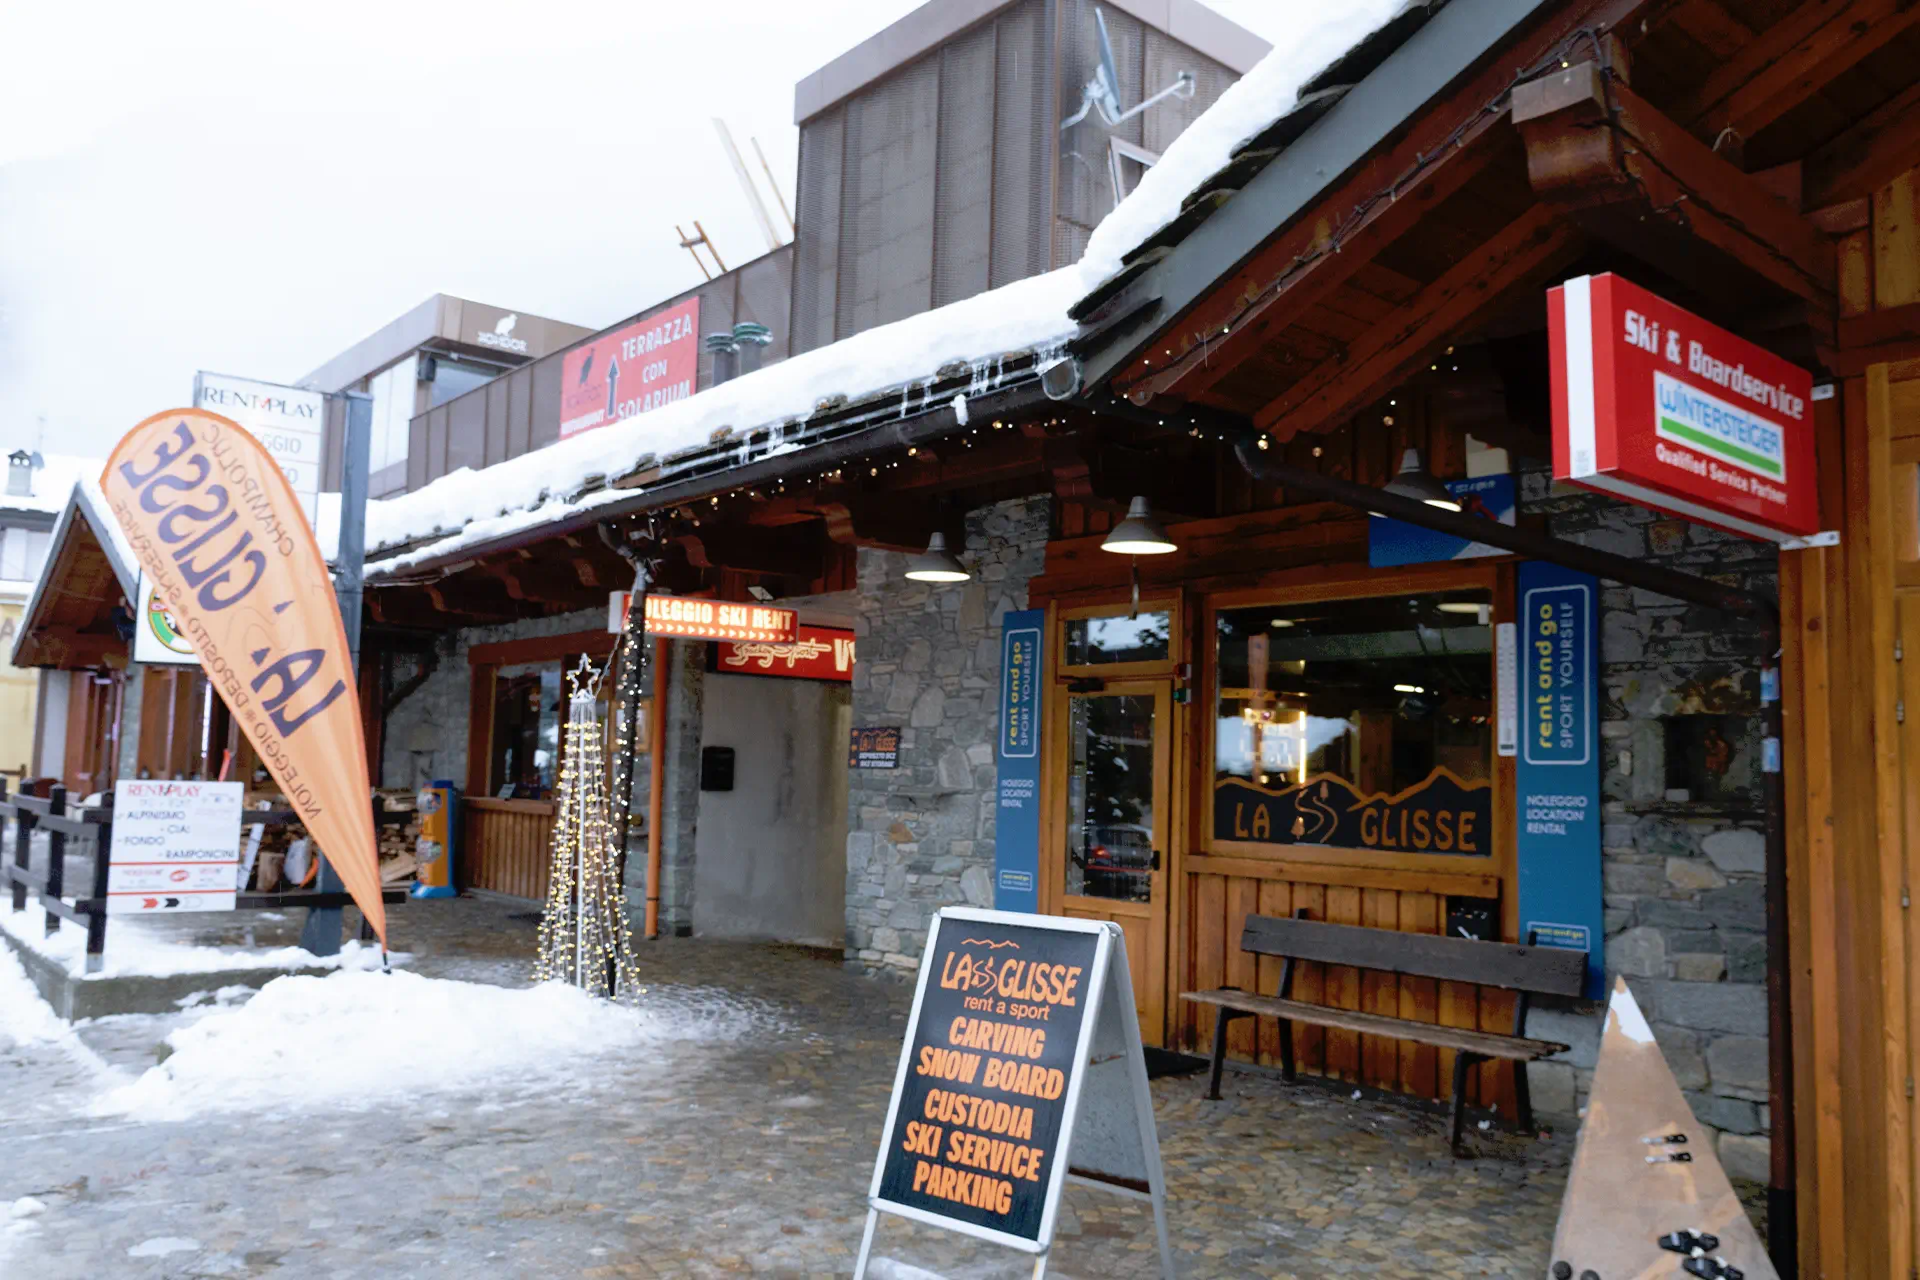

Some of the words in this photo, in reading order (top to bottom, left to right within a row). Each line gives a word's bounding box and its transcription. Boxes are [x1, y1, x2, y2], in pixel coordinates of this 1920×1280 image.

[622, 313, 692, 362] TERRAZZA
[642, 360, 668, 384] CON
[1624, 309, 1659, 355] Ski
[1665, 330, 1681, 365] &
[1689, 339, 1804, 420] Boardservice
[618, 379, 690, 420] SOLARIUM
[1659, 383, 1781, 457] WINTERSTEIGER
[1656, 443, 1706, 477] Qualified
[1709, 462, 1748, 493] Service
[1751, 479, 1787, 505] Partner
[718, 604, 747, 628] SKI
[752, 608, 793, 631] RENT
[1539, 603, 1557, 635] go
[1013, 641, 1022, 665] go
[1536, 640, 1552, 689] and
[1560, 602, 1574, 688] YOURSELF
[1010, 667, 1020, 704] and
[1022, 639, 1032, 701] YOURSELF
[1010, 707, 1019, 746] rent
[1020, 706, 1029, 747] SPORT
[1536, 693, 1552, 748] rent
[1560, 694, 1574, 749] SPORT
[1001, 789, 1032, 798] LOCATION
[1526, 795, 1588, 808] NOLEGGIO
[1526, 808, 1585, 821] LOCATION
[124, 836, 165, 846] FONDO
[1235, 803, 1270, 839] LA
[1361, 807, 1477, 852] GLISSE
[1527, 822, 1567, 836] RENTAL
[940, 951, 972, 991] LA
[998, 958, 1082, 1006] GLISSE
[964, 995, 992, 1012] rent
[996, 1002, 1005, 1013] a
[1010, 1002, 1051, 1021] sport
[949, 1016, 1045, 1060] CARVING
[916, 1045, 981, 1084] SNOW
[982, 1058, 1064, 1101] BOARD
[924, 1088, 1034, 1140] CUSTODIA
[903, 1120, 943, 1158] SKI
[946, 1129, 1044, 1182] SERVICE
[912, 1160, 1013, 1215] PARKING
